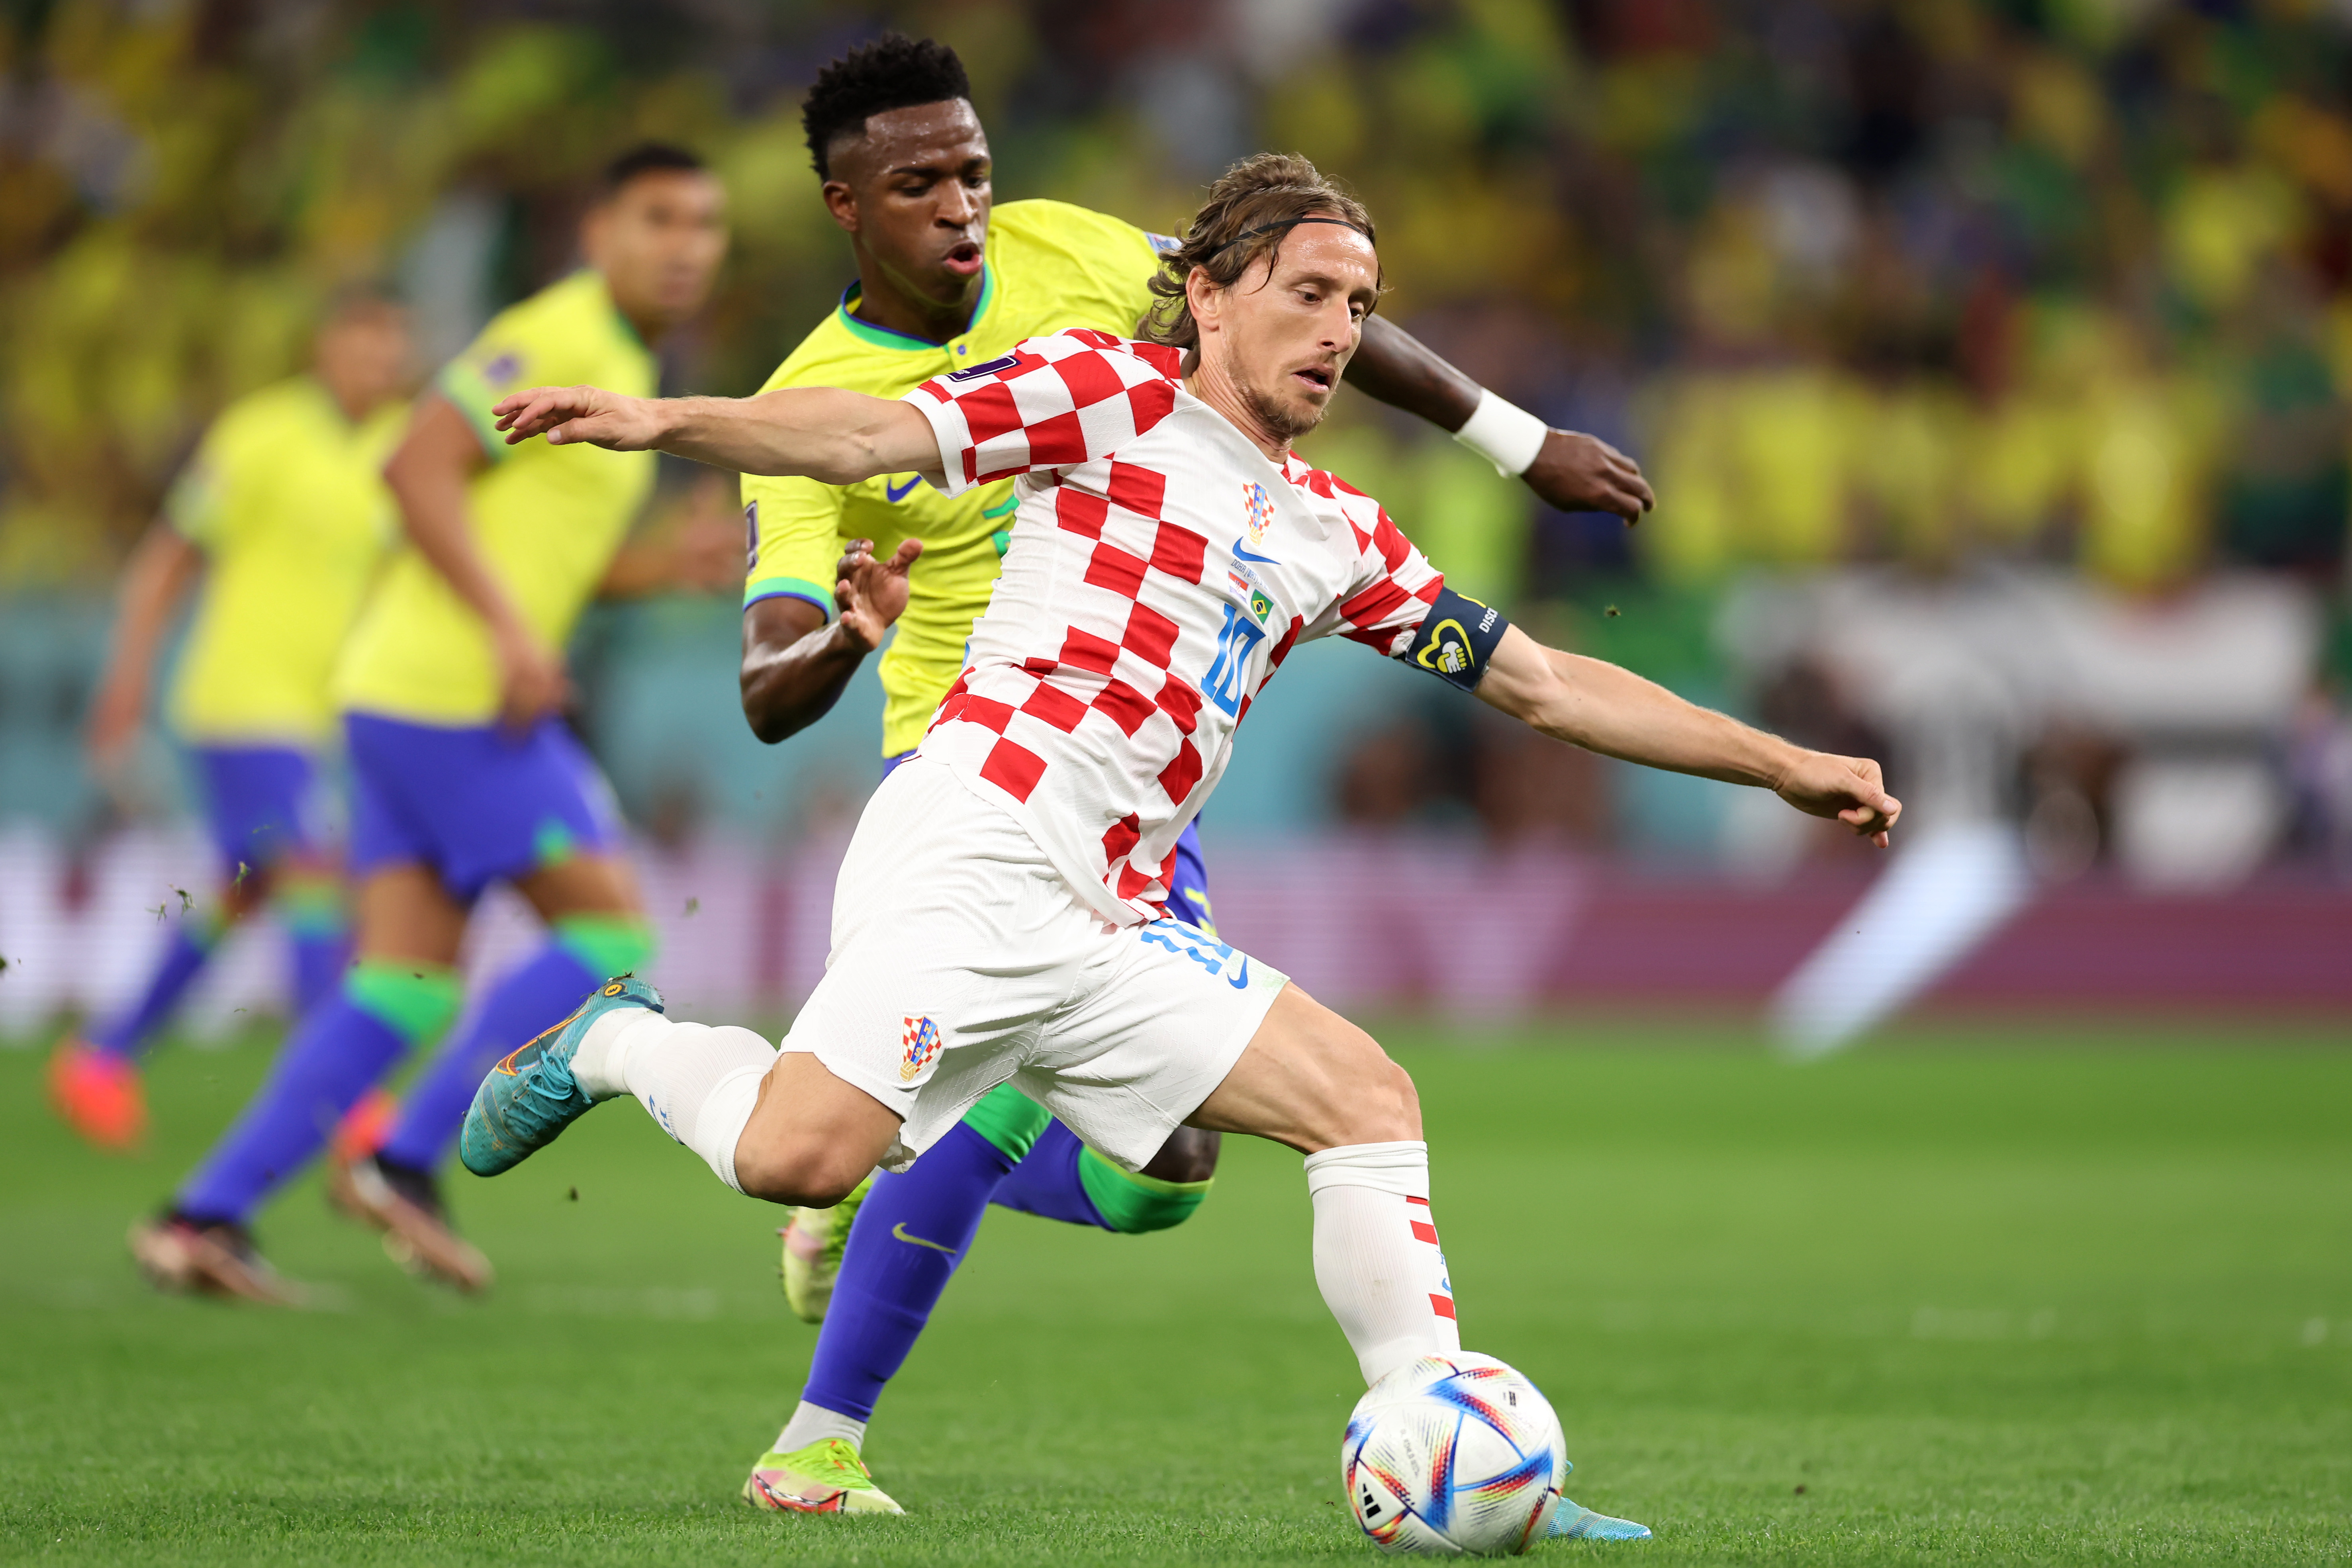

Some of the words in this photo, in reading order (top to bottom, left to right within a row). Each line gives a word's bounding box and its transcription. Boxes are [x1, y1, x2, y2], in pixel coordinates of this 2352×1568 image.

[1231, 559, 1246, 573] DOHA
[1200, 603, 1266, 718] 10
[914, 1023, 932, 1057] HNS
